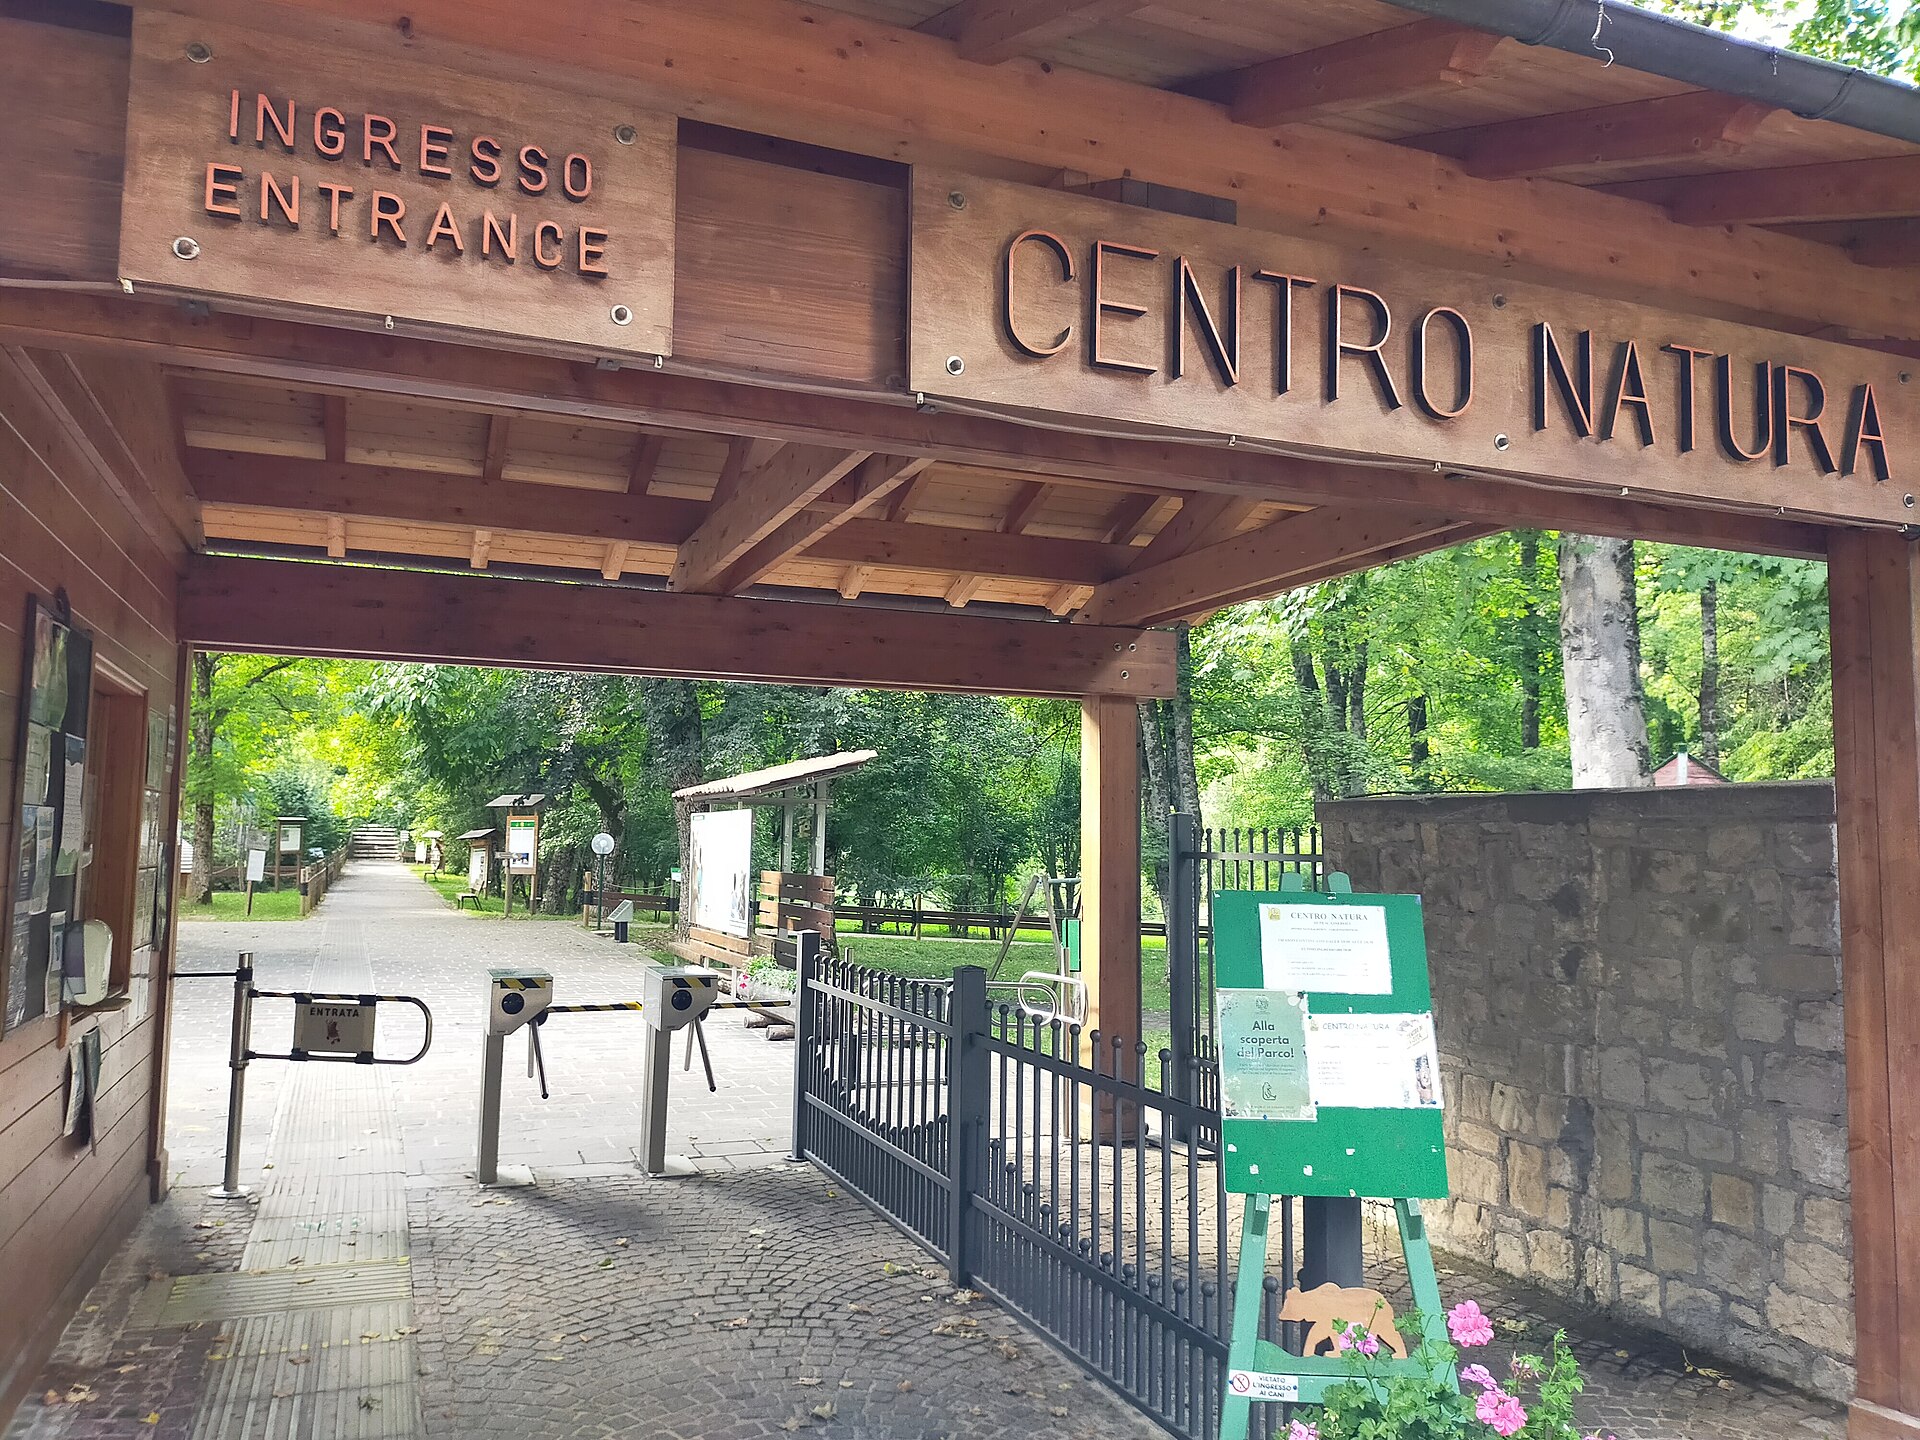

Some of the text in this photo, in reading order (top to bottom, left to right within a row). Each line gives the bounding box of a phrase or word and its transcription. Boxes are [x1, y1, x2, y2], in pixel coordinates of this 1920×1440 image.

[228, 89, 594, 203] INGRESSO
[204, 162, 609, 277] ENTRANCE
[1004, 228, 1890, 482] CENTRO NATURA
[1290, 912, 1368, 921] CENTRO NATURA
[310, 1007, 359, 1017] ENTRATA
[1252, 1020, 1275, 1031] Alla
[1322, 1022, 1354, 1030] CENTRO
[1240, 1036, 1290, 1046] scoperta
[1237, 1047, 1294, 1058] del Parco!
[1258, 1375, 1286, 1384] VIETATO
[1252, 1382, 1292, 1392] L'INGRESSO
